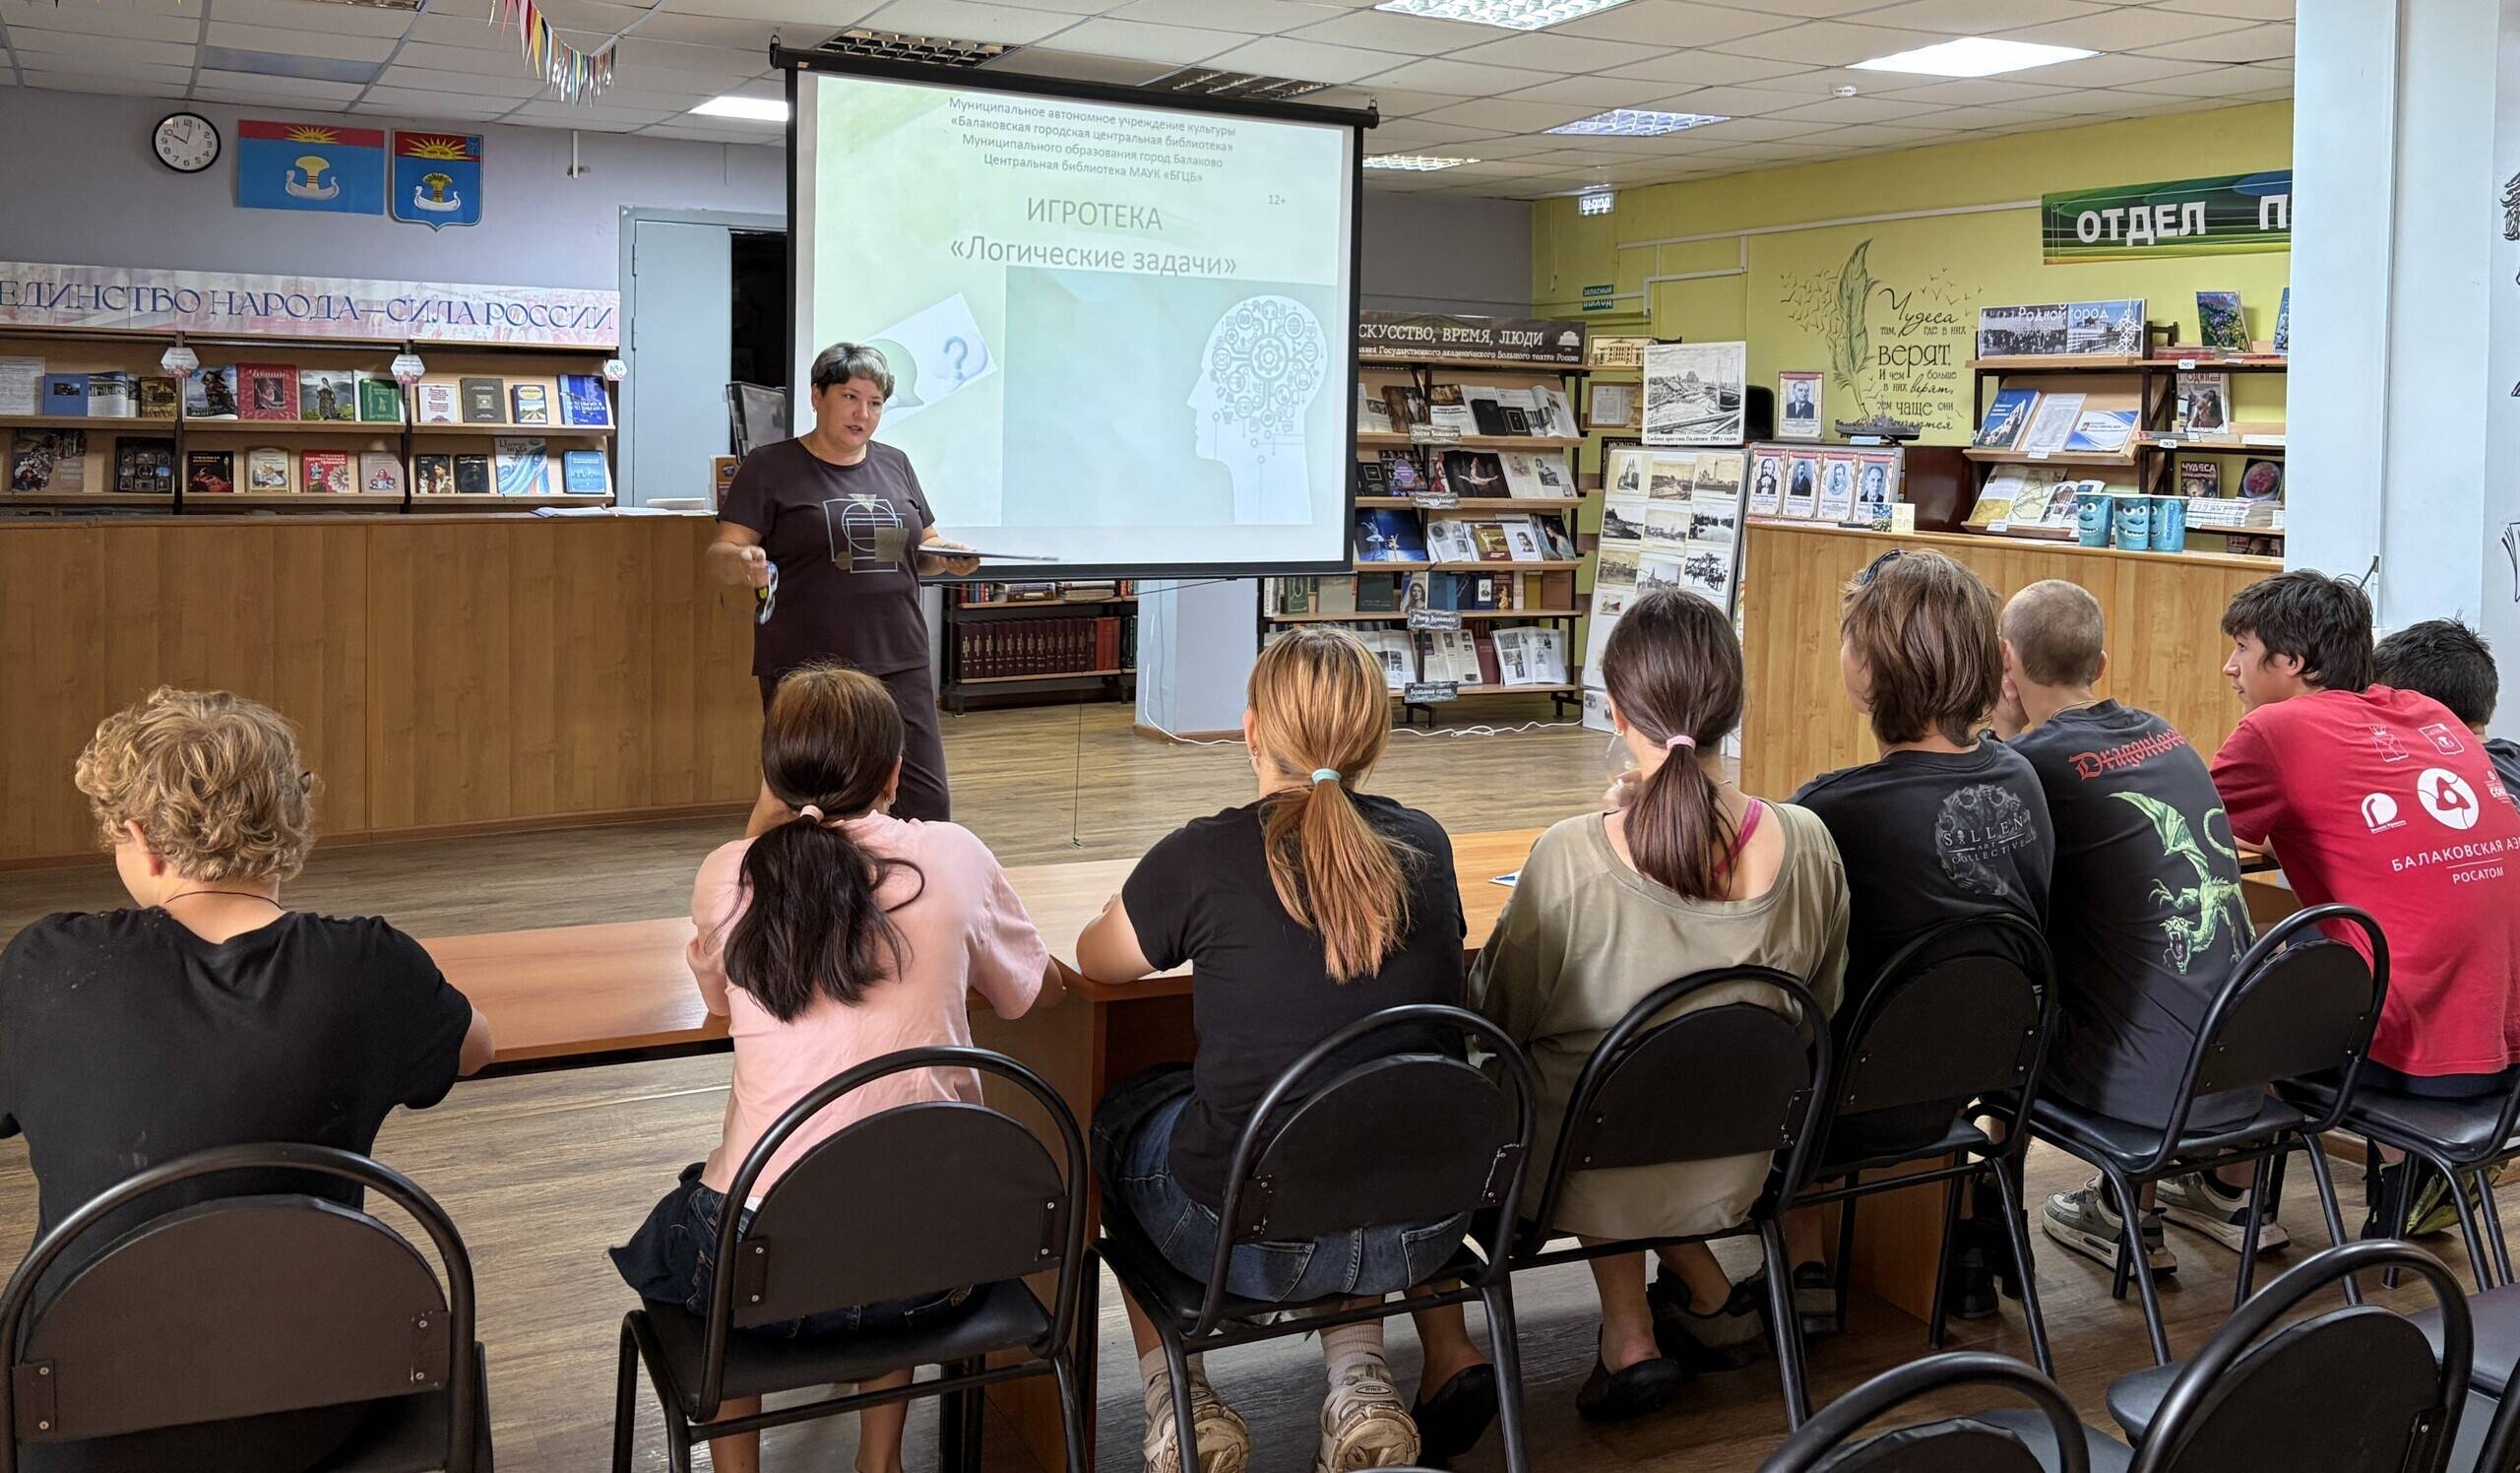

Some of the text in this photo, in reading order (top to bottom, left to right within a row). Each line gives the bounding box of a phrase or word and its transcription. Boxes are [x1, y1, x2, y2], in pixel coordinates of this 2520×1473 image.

[949, 96, 1235, 138] Муниципальное автономное учреждение культуры
[951, 115, 1233, 152] «Балаковская городская центральная библиотека»
[963, 133, 1224, 167] Муниципального образования город Балаково
[984, 154, 1203, 184] Центральная библиотека МАУК «БГЦБ»
[1028, 197, 1164, 230] ИГРОТЕКА
[1268, 194, 1286, 206] 12+
[2076, 201, 2206, 246] ОТДЕЛ
[950, 235, 1236, 277] «Логические задачи»
[0, 280, 201, 316] ЕДИНСТВО
[485, 301, 614, 330] РОССИИ
[1877, 288, 1959, 338] Чудеса
[2018, 303, 2066, 322] Родной
[1442, 328, 1493, 347] ВРЕМЯ,
[1499, 330, 1544, 348] ЛЮДИ
[1880, 326, 1966, 335] там, где в них
[1379, 346, 1441, 356] Государственного
[1498, 351, 1531, 360] Большого
[1556, 352, 1579, 361] России
[1878, 344, 1951, 378] верят.
[1879, 368, 1957, 380] И чем больше
[1893, 383, 1908, 392] них
[1896, 401, 1933, 416] чаще
[1937, 402, 1954, 411] они
[2181, 463, 2216, 472] ЧУДЕСА
[1944, 815, 2024, 847] SLLEN
[1978, 841, 1995, 851] ART
[2391, 839, 2503, 872] БАЛАКОВСКАЯ
[2452, 866, 2505, 884] РОСАТОМ
